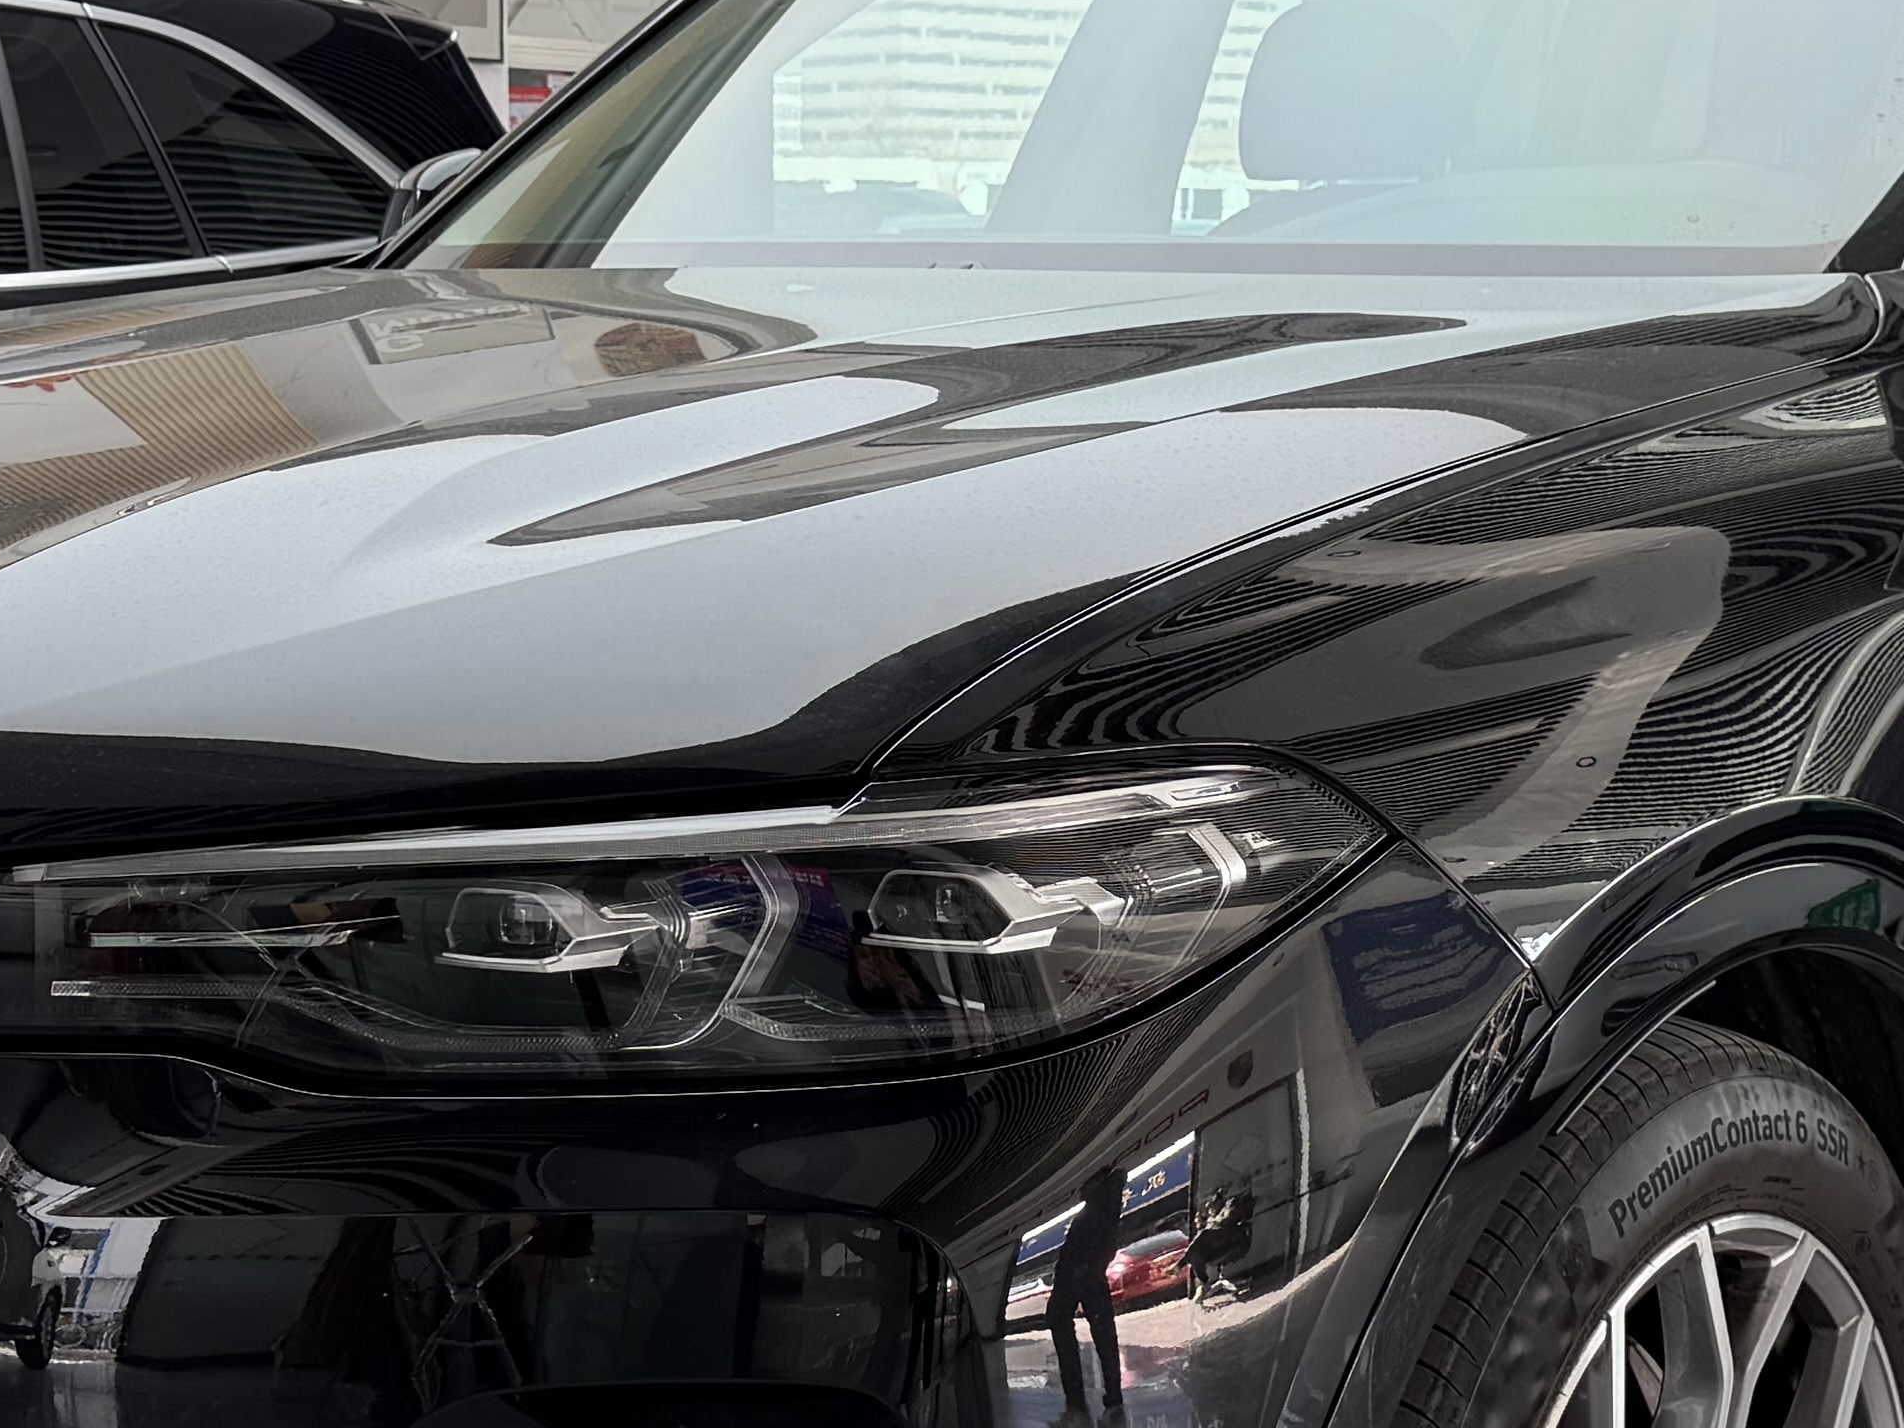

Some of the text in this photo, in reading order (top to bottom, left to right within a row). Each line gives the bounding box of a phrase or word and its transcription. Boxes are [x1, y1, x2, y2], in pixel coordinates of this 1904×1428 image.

[1607, 1108, 1793, 1239] PremiumContact
[1794, 1109, 1809, 1145] 6
[1815, 1116, 1851, 1167] SSR
